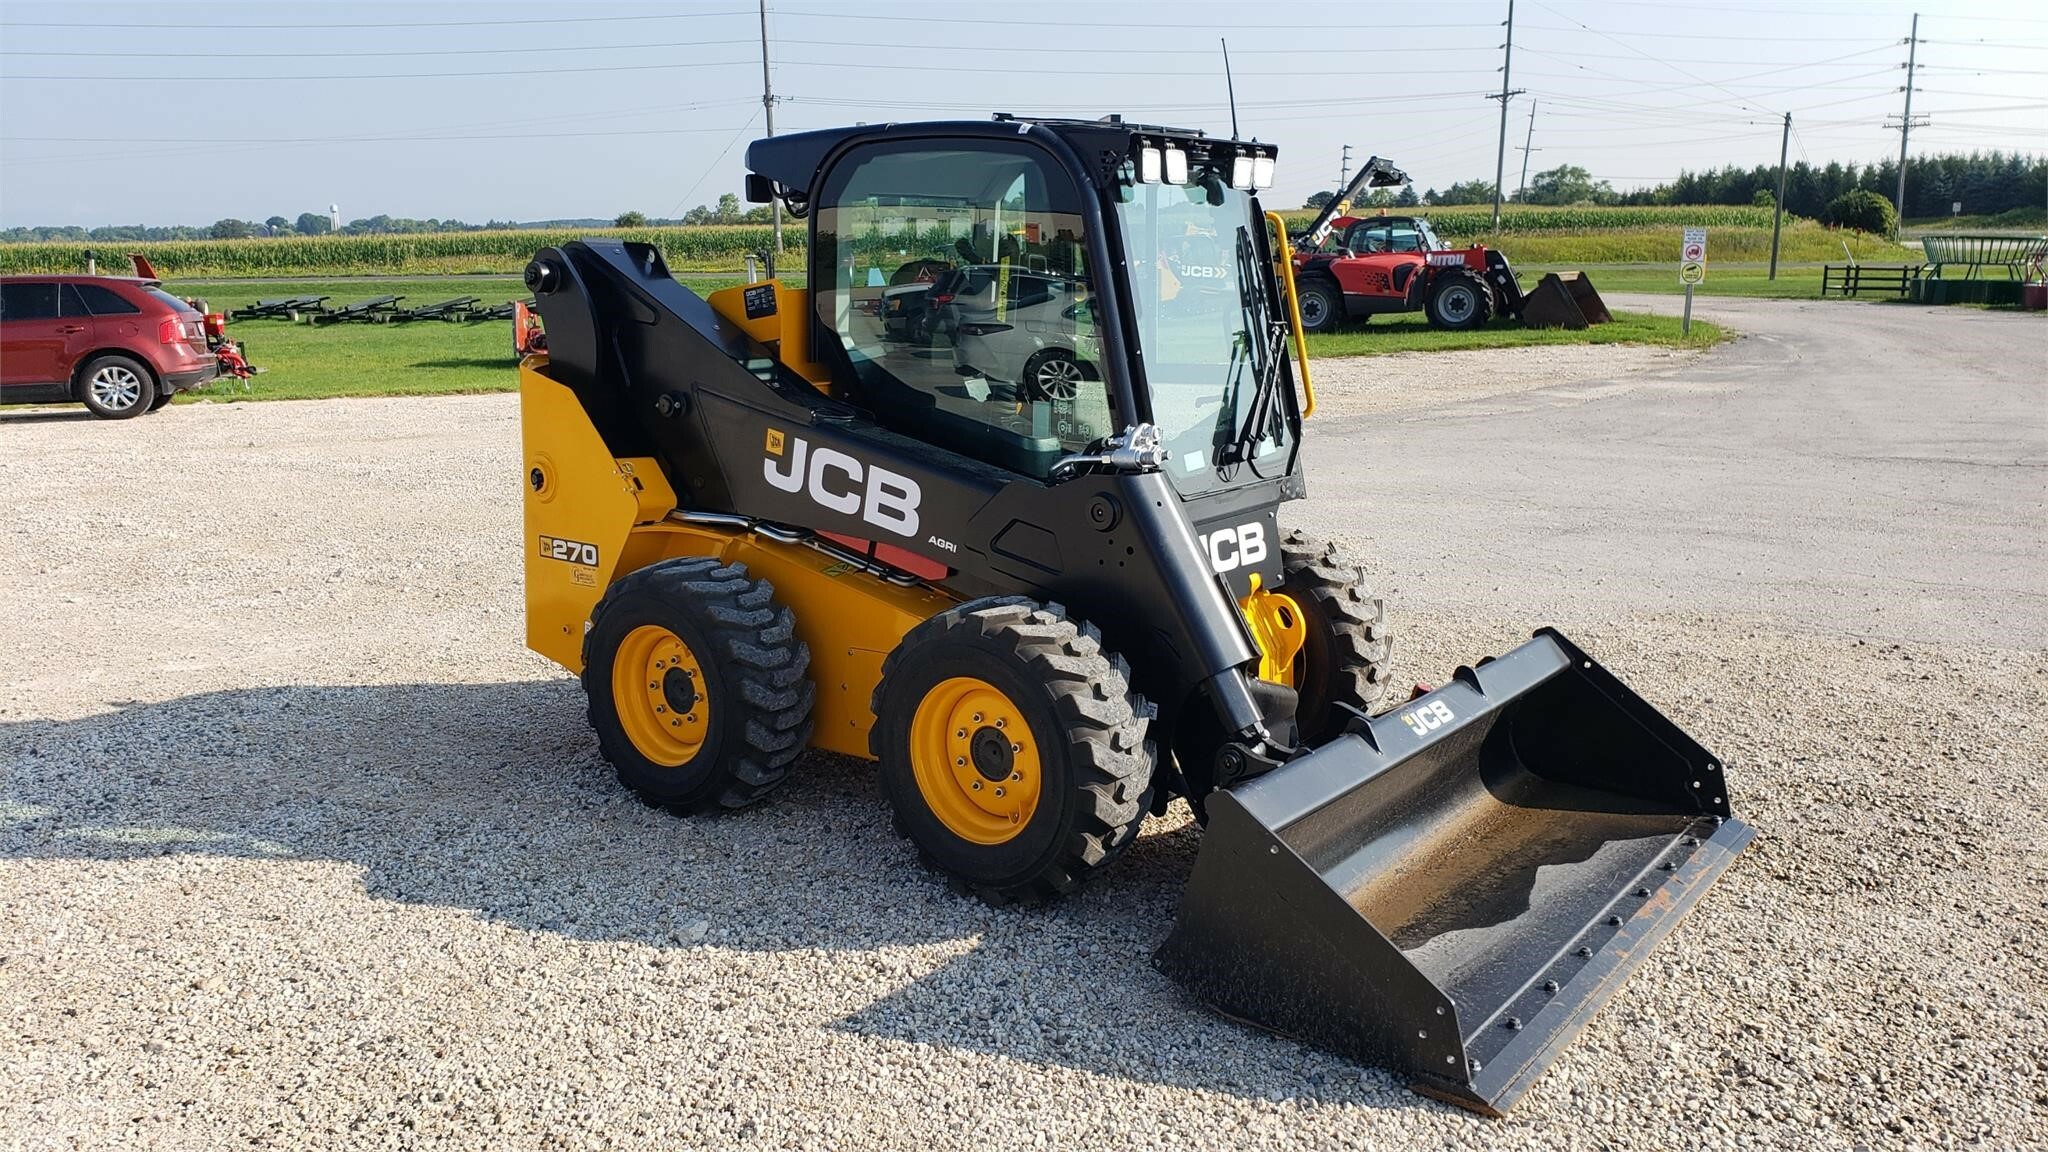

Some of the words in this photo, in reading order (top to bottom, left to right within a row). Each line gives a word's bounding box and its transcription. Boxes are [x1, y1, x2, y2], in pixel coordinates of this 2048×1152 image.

[1181, 265, 1213, 278] JCB
[764, 437, 922, 537] JCB
[553, 539, 597, 565] 270
[928, 535, 957, 553] AGRI
[1198, 521, 1267, 573] CB
[1411, 700, 1455, 736] JCB
